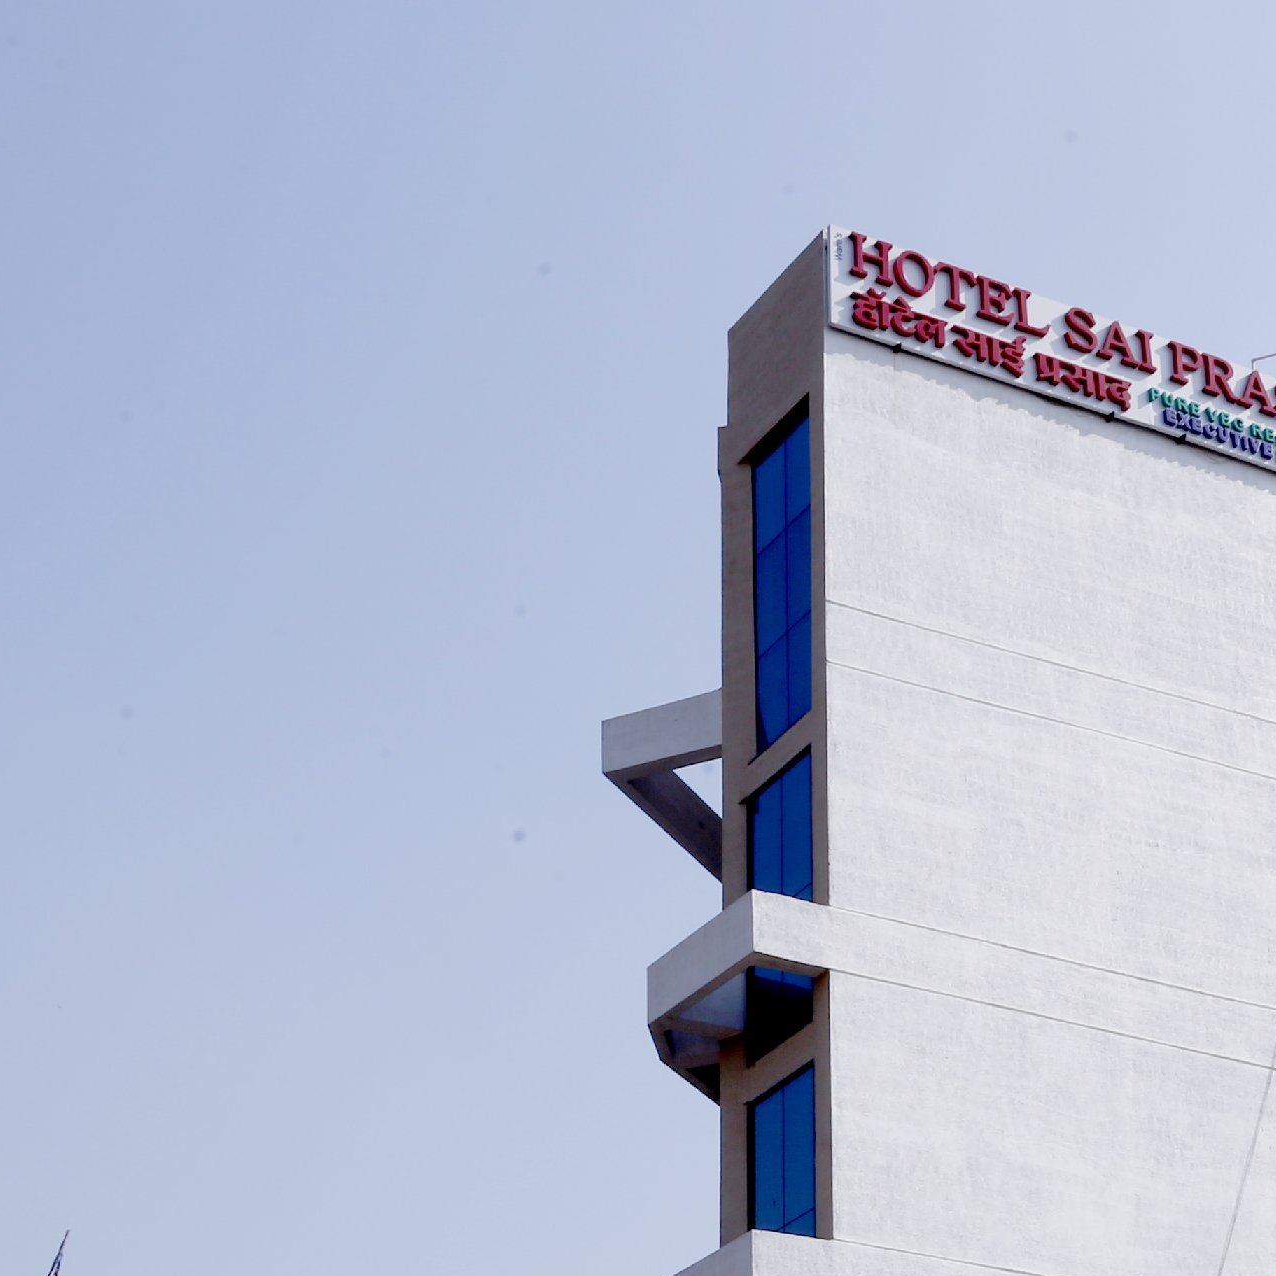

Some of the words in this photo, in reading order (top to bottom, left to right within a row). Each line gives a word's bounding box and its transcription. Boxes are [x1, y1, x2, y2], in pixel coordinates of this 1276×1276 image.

[849, 231, 1051, 339] HOTEL
[1063, 306, 1156, 375] SAI
[951, 325, 1027, 378] साई
[1033, 352, 1132, 412] प्रसाद
[1148, 387, 1201, 418] PURE
[1204, 405, 1245, 433] VEG
[1163, 408, 1274, 460] EXECUTIVE
